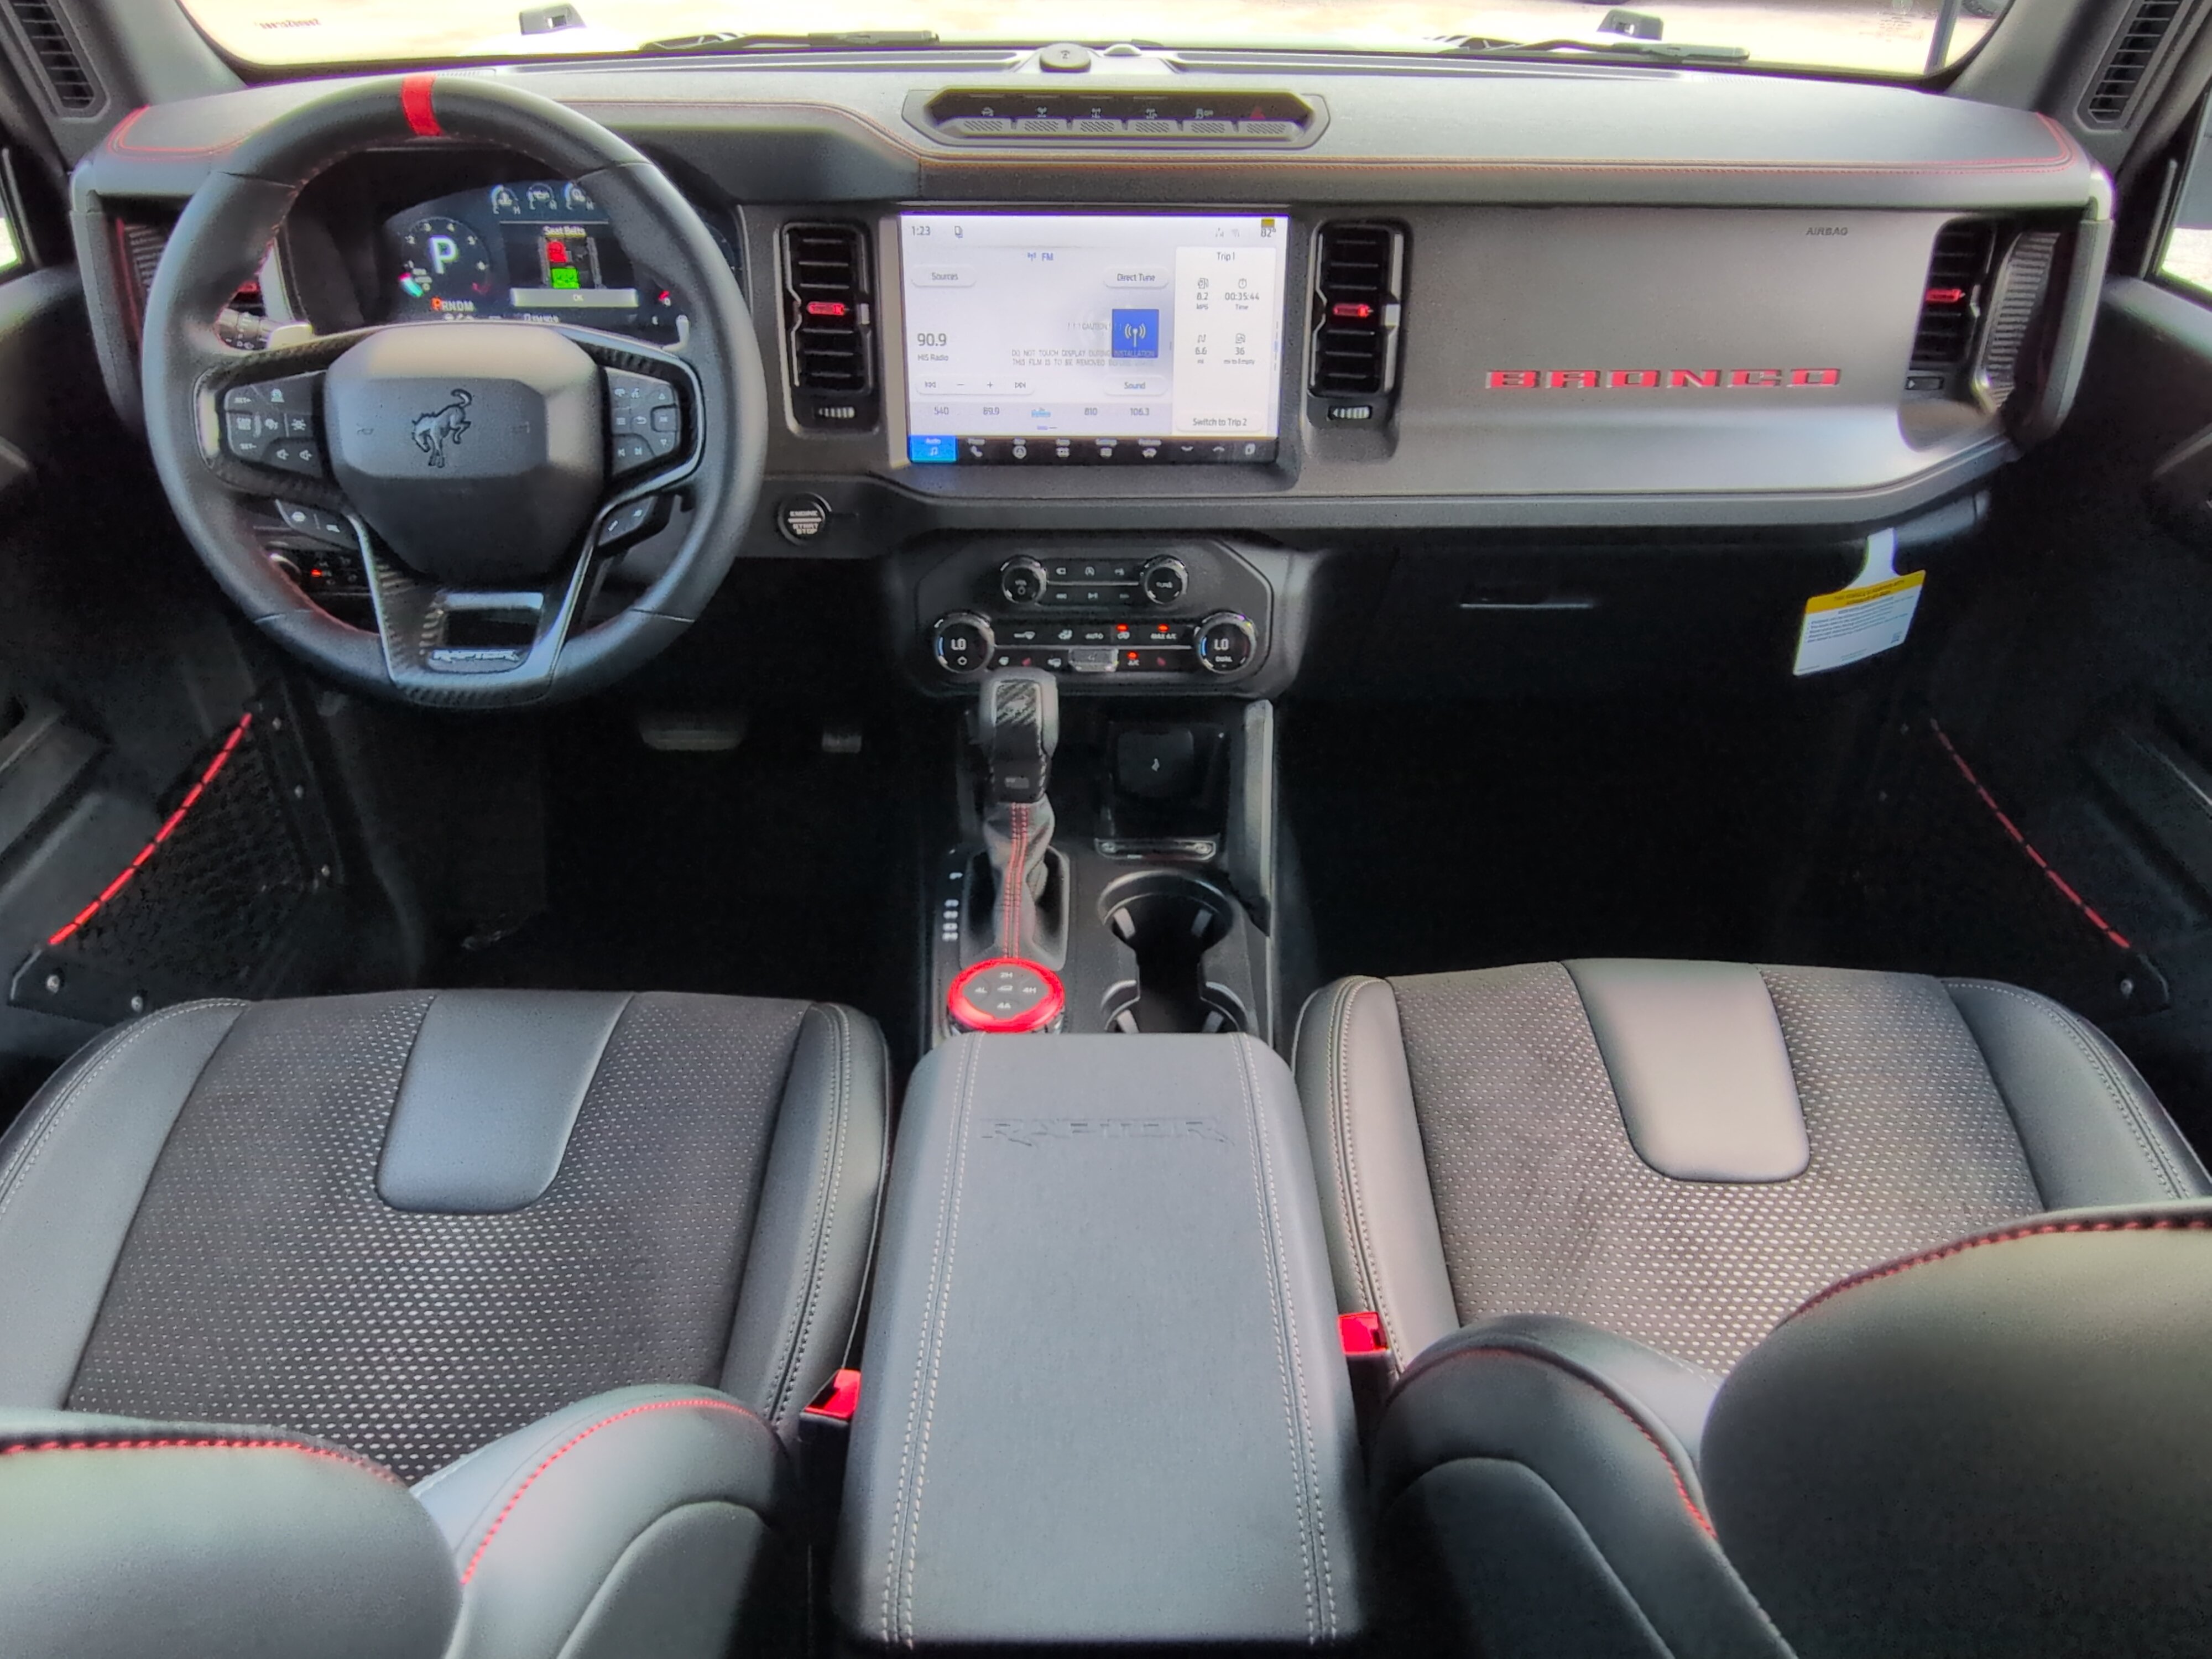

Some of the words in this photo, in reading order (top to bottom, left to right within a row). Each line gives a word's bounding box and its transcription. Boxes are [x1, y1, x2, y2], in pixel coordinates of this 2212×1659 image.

[543, 226, 563, 237] Seat
[564, 226, 586, 237] Belts
[912, 226, 931, 236] 1:23
[1806, 227, 1848, 236] AIRBAG
[429, 235, 459, 274] P
[1042, 252, 1053, 261] FM
[1217, 252, 1231, 261] Trip
[932, 272, 958, 281] Sources
[1117, 273, 1137, 282] Direct
[1139, 273, 1156, 282] Tune
[1225, 292, 1260, 301] 00:35:44
[917, 333, 947, 346] 90.9
[1195, 347, 1207, 355] 6.6
[1235, 347, 1245, 356] 36
[1485, 368, 1843, 389] BRONCO
[1124, 382, 1146, 390] Sound
[1084, 408, 1098, 416] 810
[1130, 408, 1150, 416] 106.3
[1193, 418, 1217, 426] Switch
[1218, 418, 1226, 426] to
[1228, 418, 1241, 427] Trip
[951, 638, 967, 651] LO
[1214, 638, 1229, 651] LO
